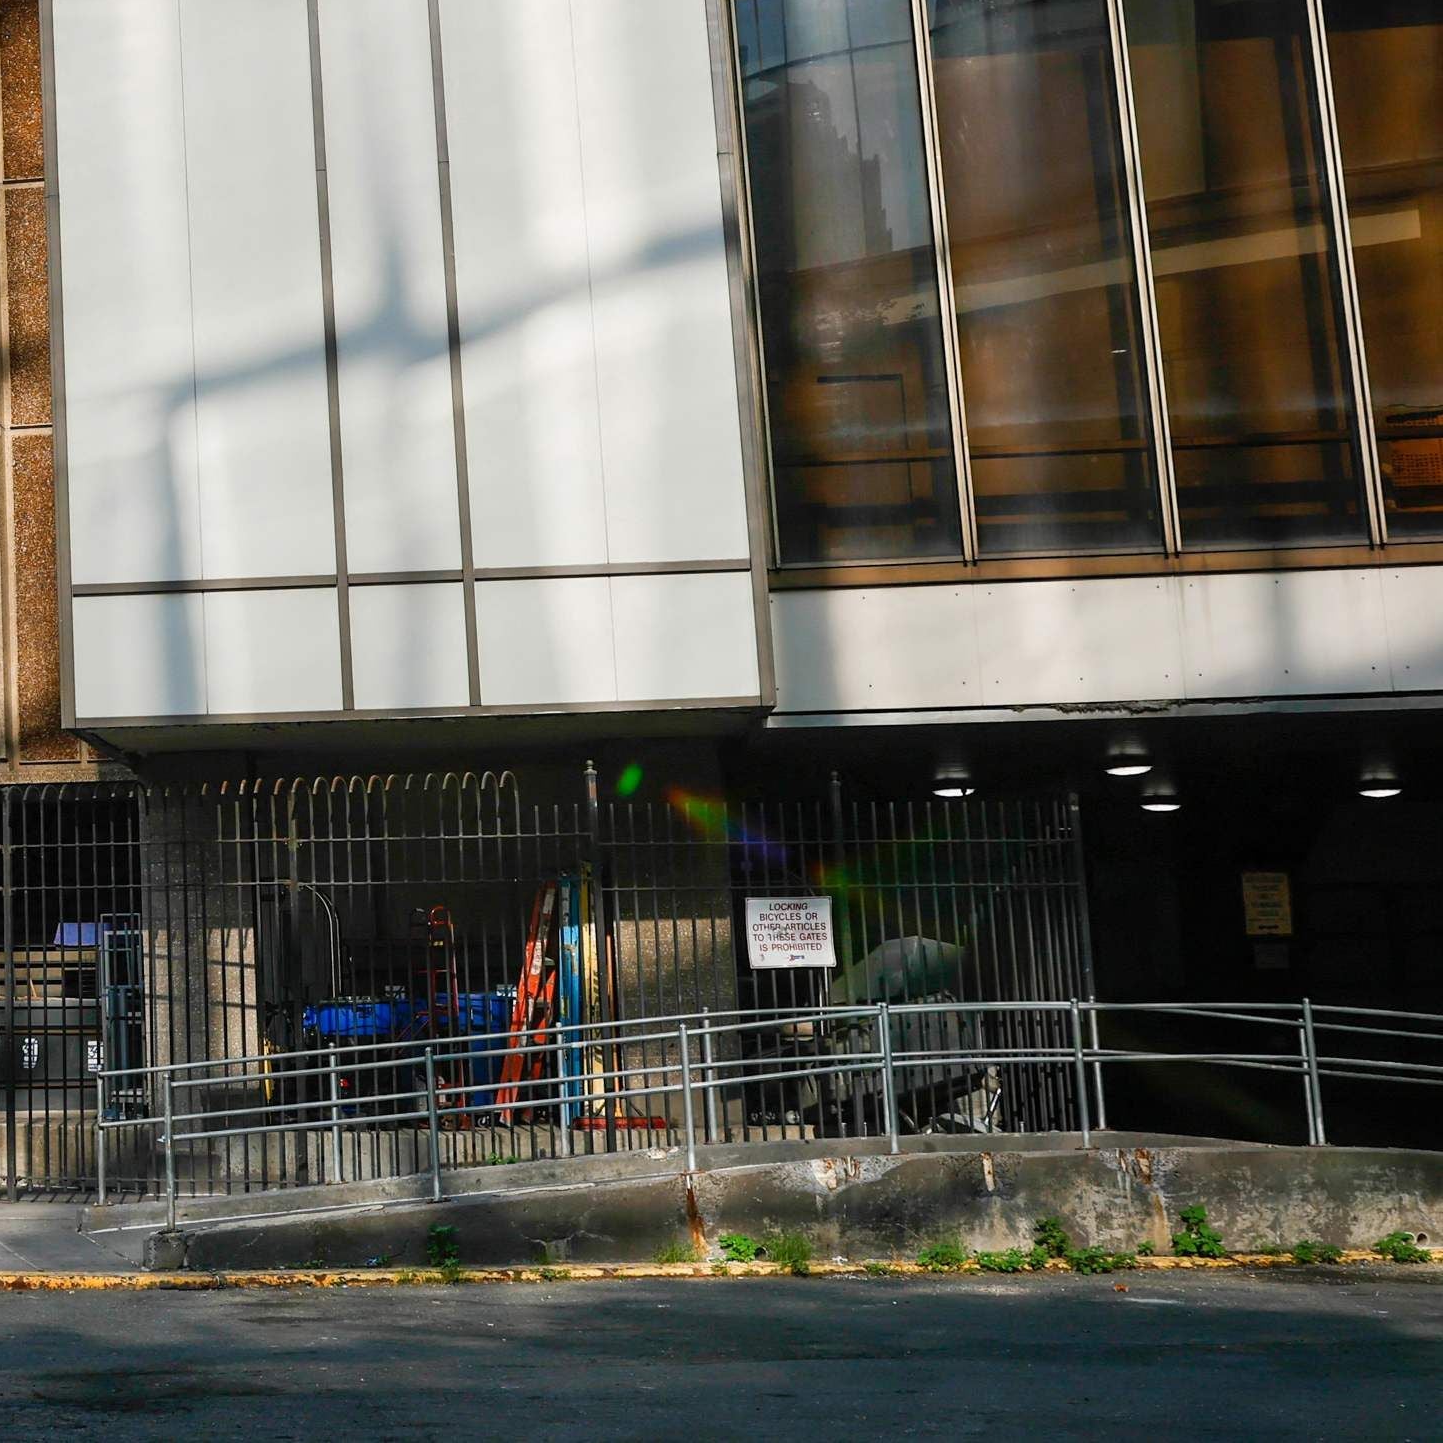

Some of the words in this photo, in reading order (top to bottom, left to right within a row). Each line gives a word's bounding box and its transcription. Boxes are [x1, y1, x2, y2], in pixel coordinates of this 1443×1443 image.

[769, 903, 808, 911] LOCKING
[759, 912, 801, 921] BICYCLES
[805, 912, 818, 921] OR
[752, 923, 781, 931] OTHER
[785, 922, 826, 931] ARTICLES
[754, 933, 765, 942] TO
[768, 933, 795, 942] THESE
[799, 932, 828, 941] GATES
[759, 943, 768, 952] IS
[771, 942, 822, 951] PROHIBITED
